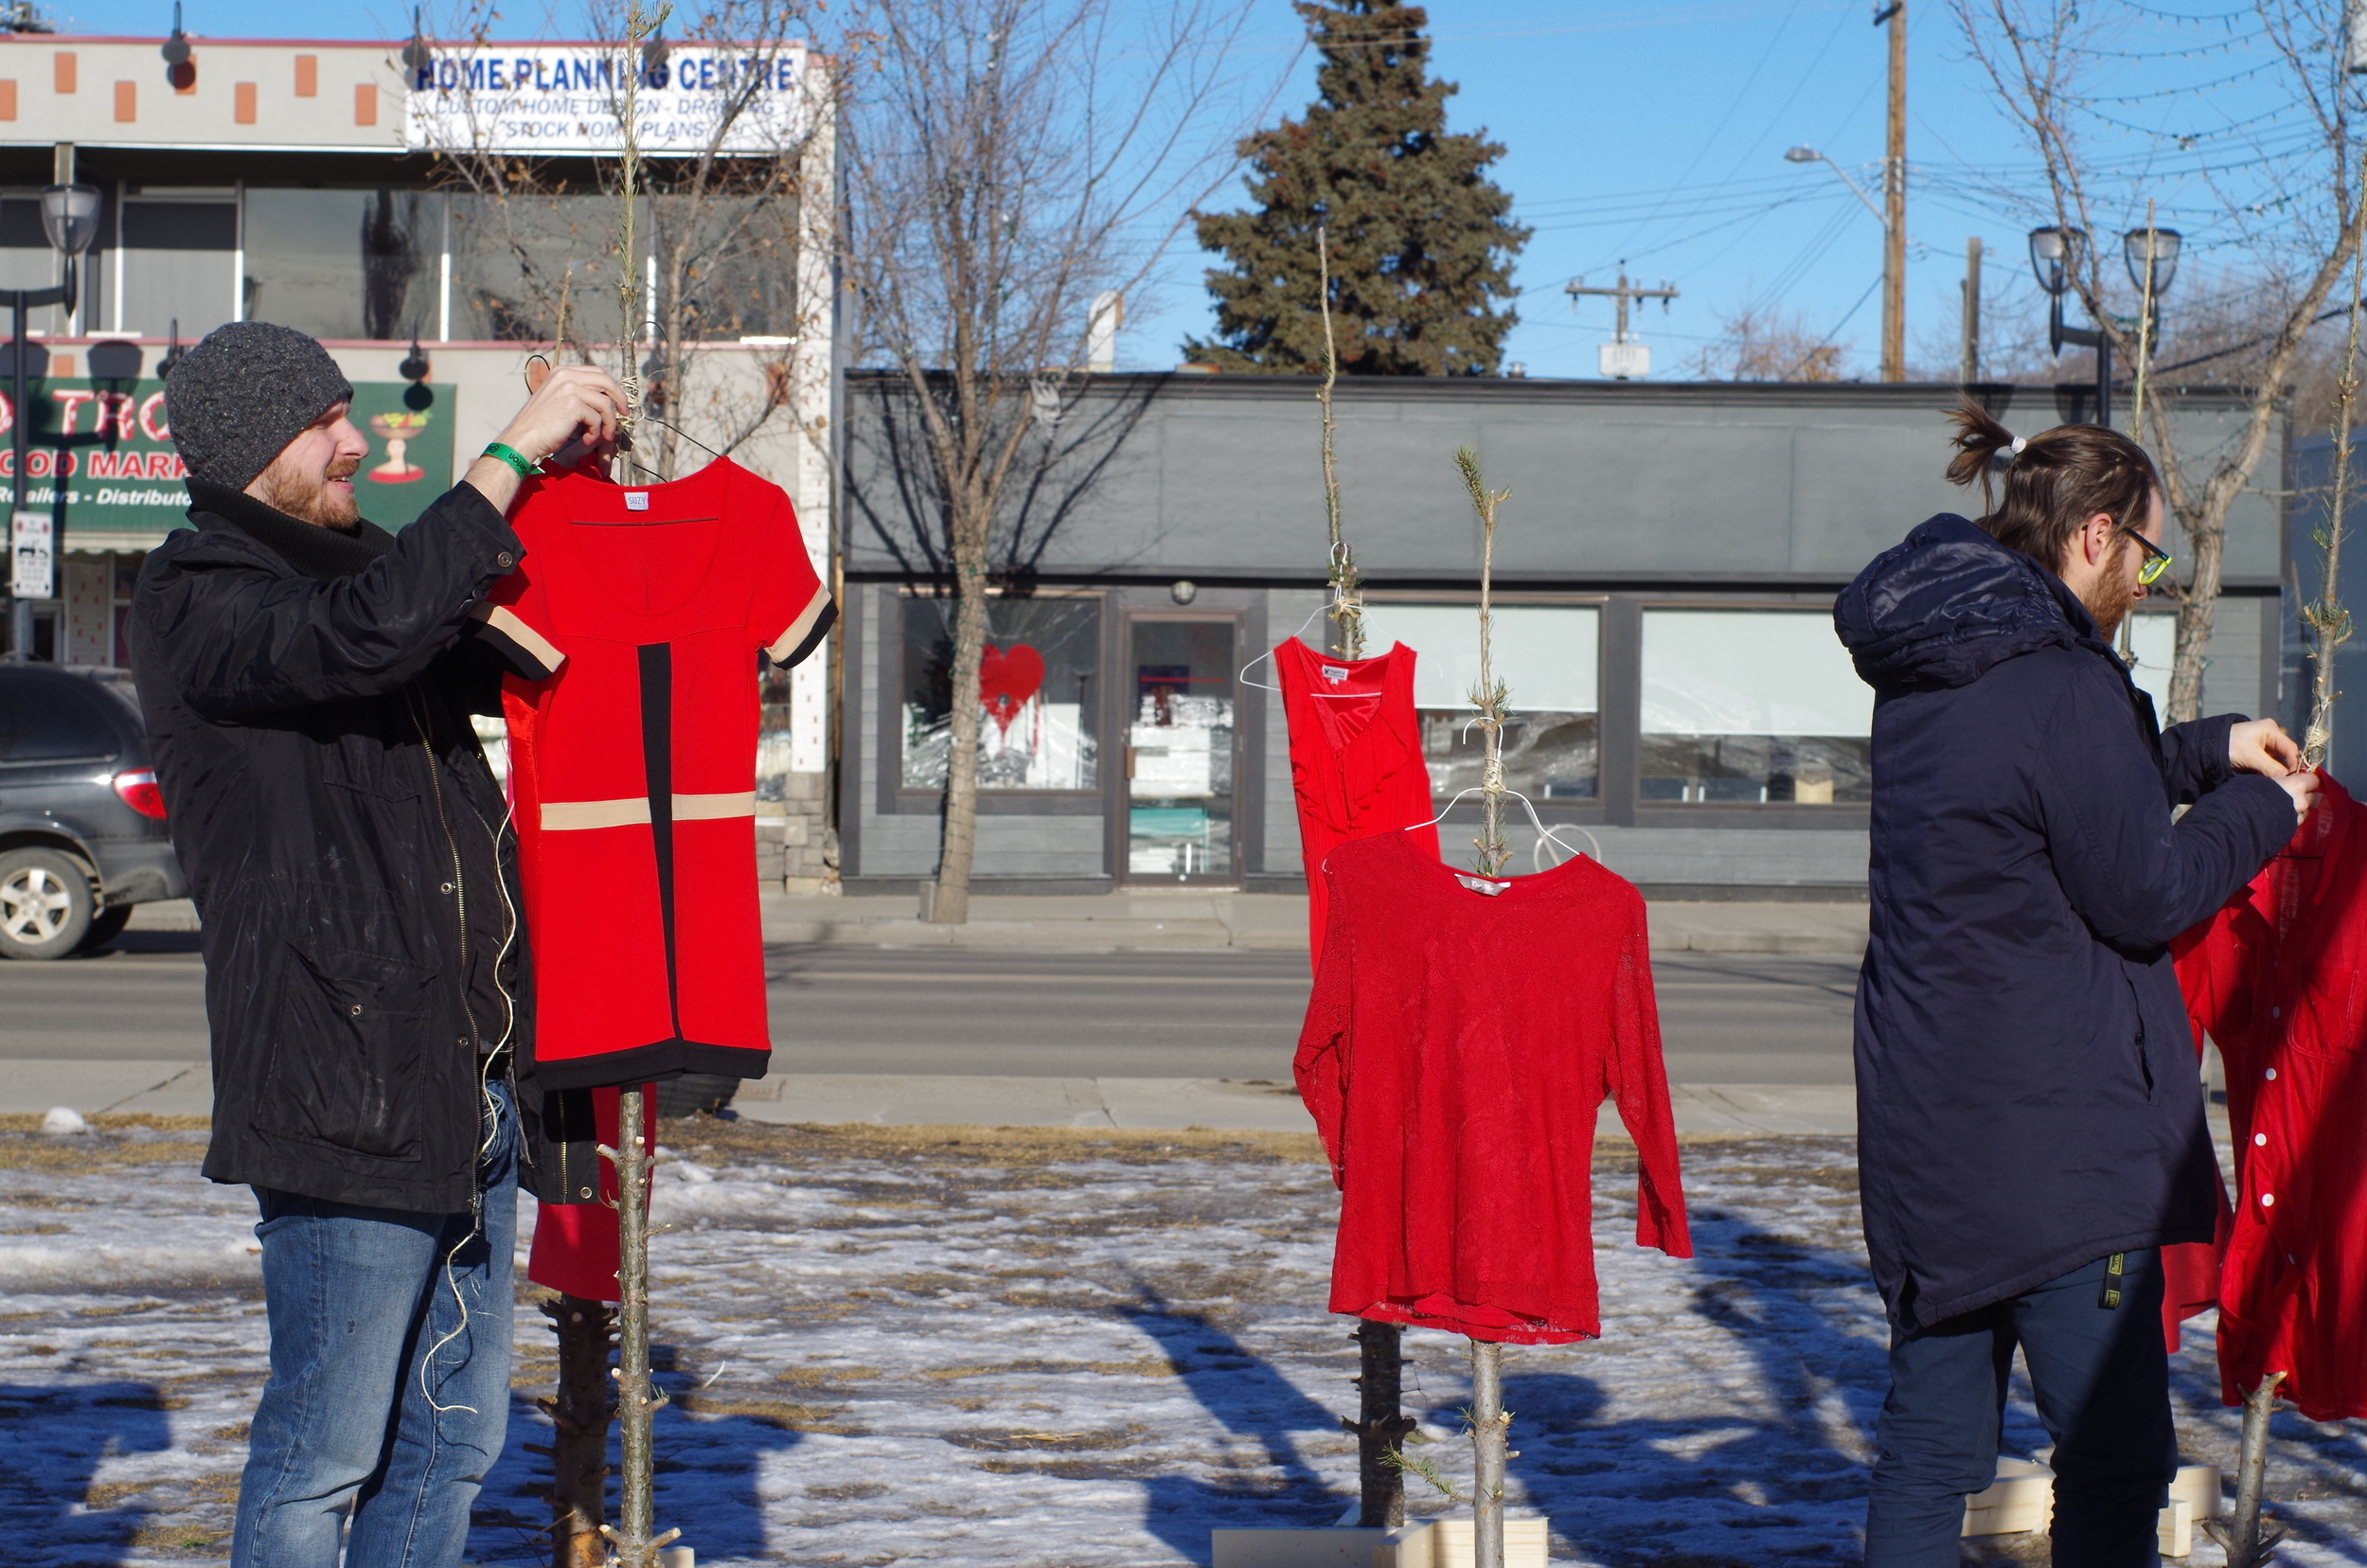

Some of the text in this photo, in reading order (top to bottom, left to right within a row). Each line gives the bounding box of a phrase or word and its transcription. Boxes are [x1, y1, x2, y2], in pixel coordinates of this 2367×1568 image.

[418, 58, 792, 90] HOME PLANNING CENTRE
[523, 98, 579, 115] HOME
[587, 98, 660, 115] DEGN
[506, 120, 704, 137] STOCK HOM PLANS
[0, 486, 80, 504] Reailers
[628, 496, 647, 505] SUZY
